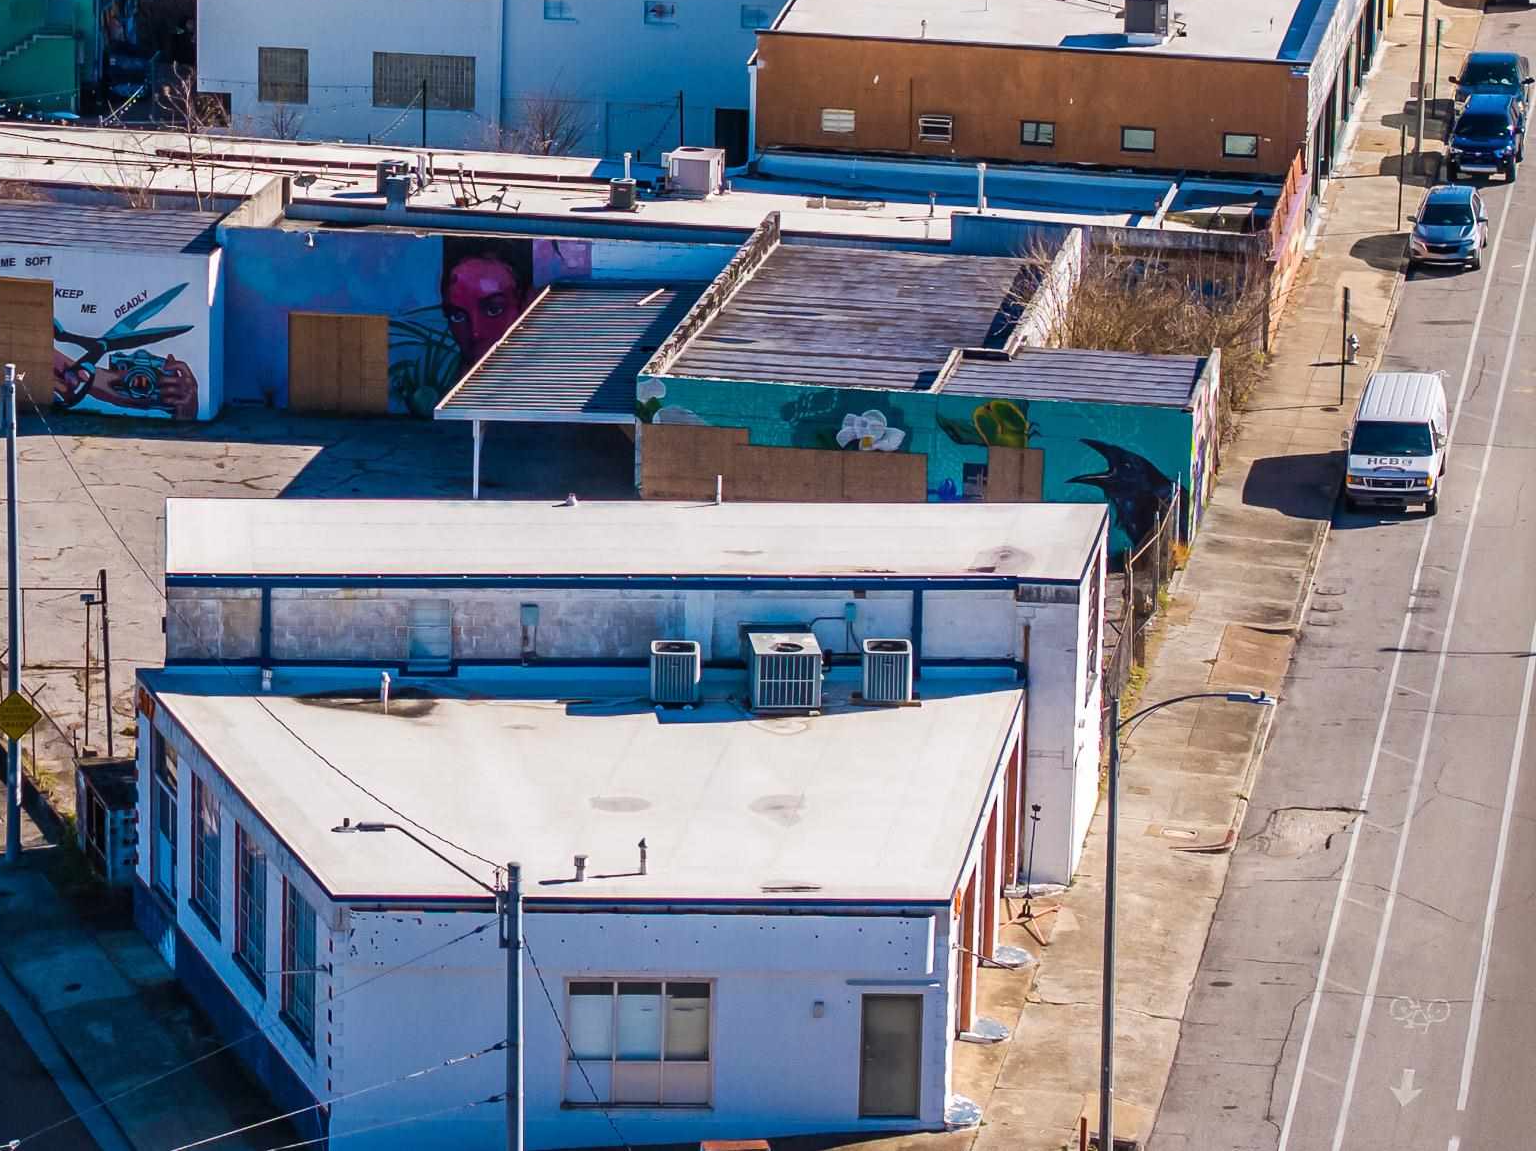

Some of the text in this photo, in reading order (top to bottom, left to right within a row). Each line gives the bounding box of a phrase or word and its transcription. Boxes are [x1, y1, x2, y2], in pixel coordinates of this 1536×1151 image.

[0, 257, 16, 267] ME
[24, 256, 53, 266] SOFT
[54, 288, 149, 319] KEEP ME DEADLY
